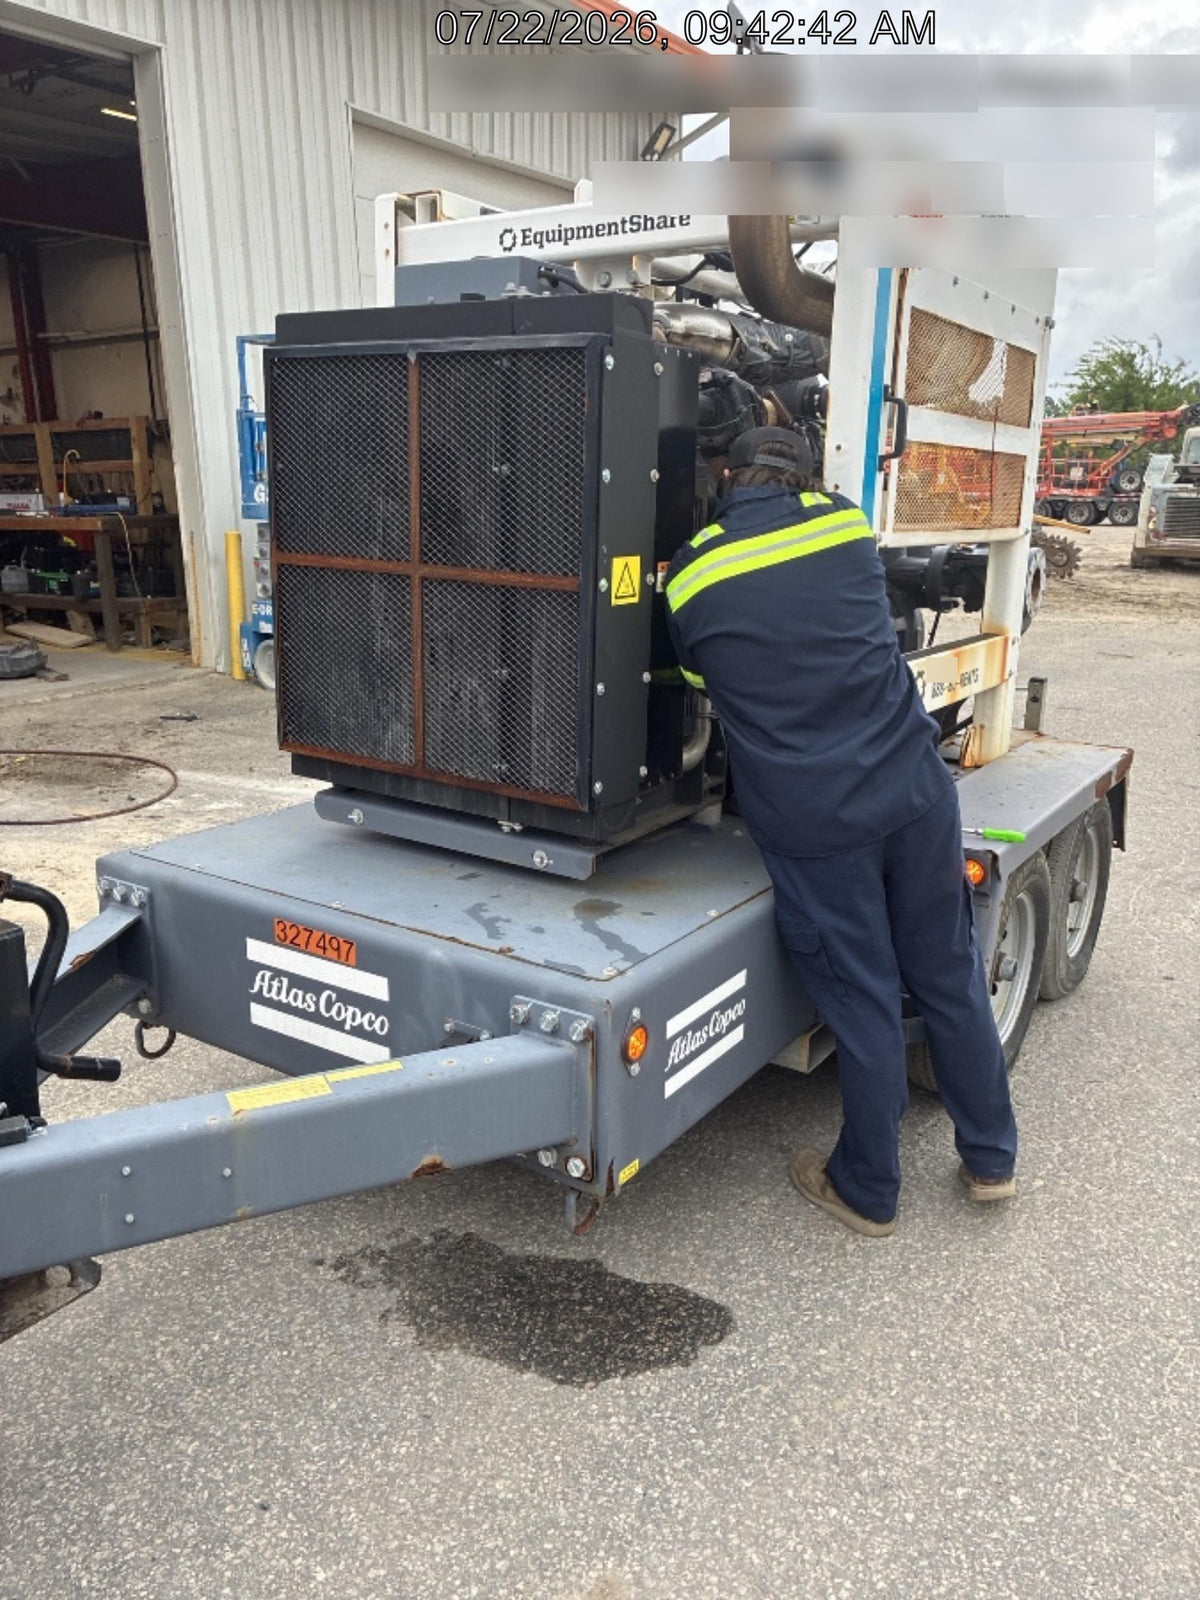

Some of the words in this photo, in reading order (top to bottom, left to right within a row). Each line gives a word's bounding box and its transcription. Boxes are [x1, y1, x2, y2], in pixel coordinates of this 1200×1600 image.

[521, 214, 691, 249] EquipmentShare
[276, 920, 354, 962] 327497
[249, 970, 317, 1013] Atlas
[319, 990, 389, 1035] Copco
[664, 1025, 708, 1072] Atlas
[709, 998, 746, 1037] Copco
